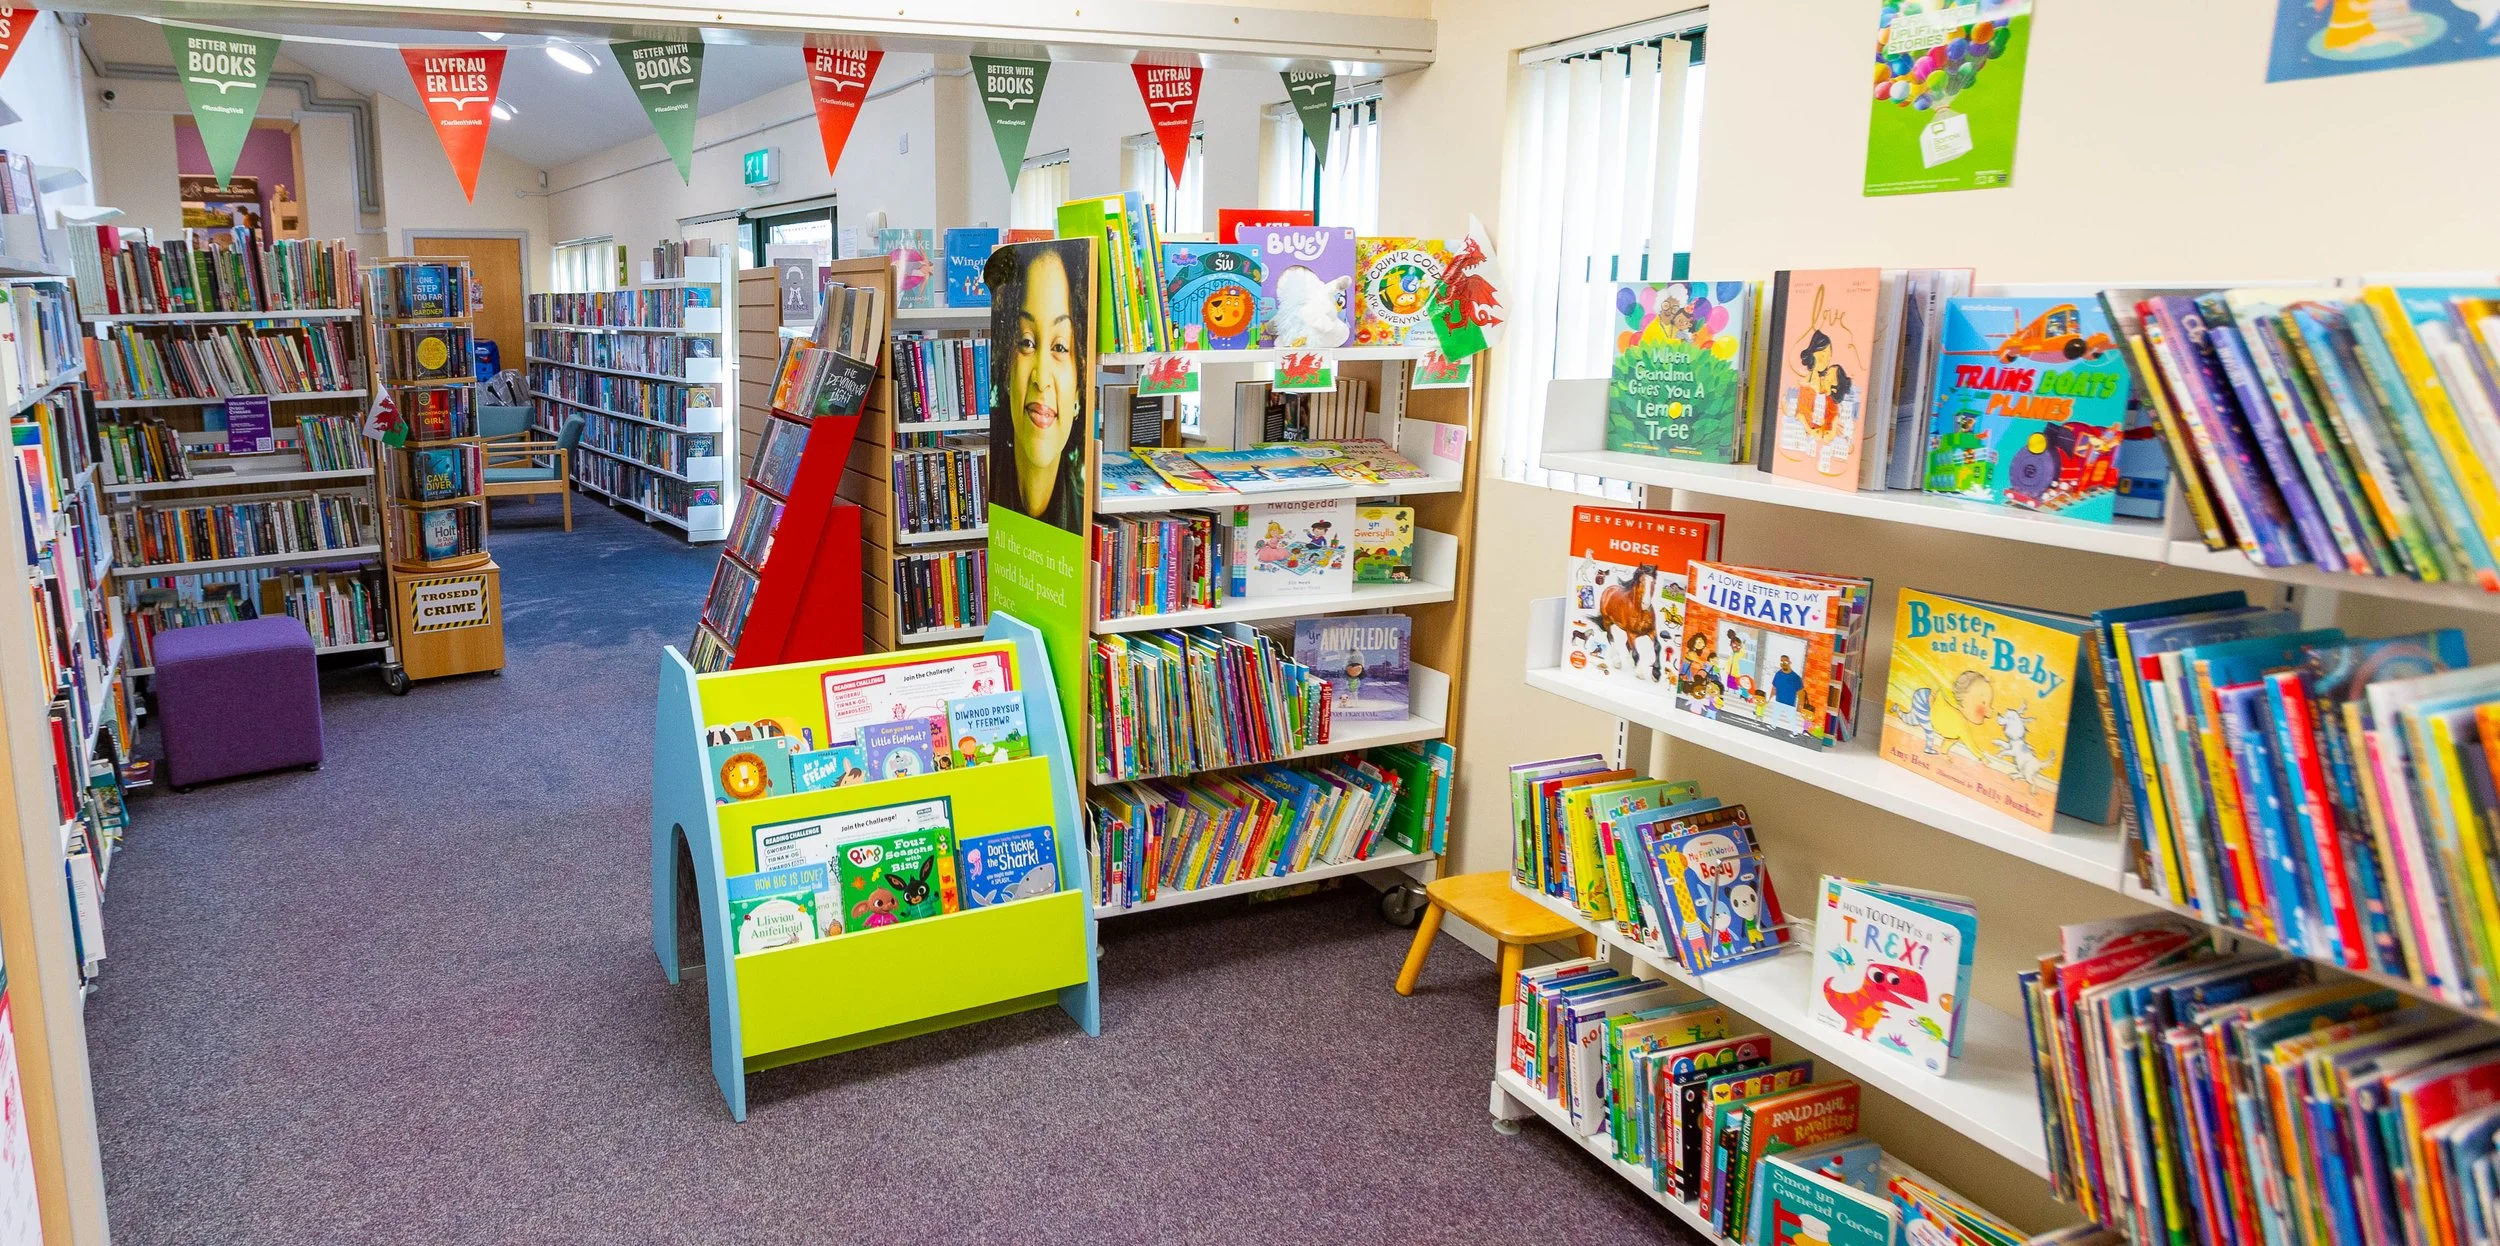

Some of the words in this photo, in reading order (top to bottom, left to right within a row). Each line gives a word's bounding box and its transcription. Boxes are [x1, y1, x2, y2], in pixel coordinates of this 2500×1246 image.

[188, 38, 227, 52] BETTER
[229, 42, 257, 56] WITH
[632, 47, 664, 59] BETTER
[665, 44, 688, 56] WITH
[1890, 34, 1943, 52] STORIES
[188, 52, 257, 77] BOOKS
[425, 57, 486, 72] LLYFRAU
[637, 56, 692, 79] BOOKS
[815, 57, 832, 72] ER
[835, 60, 866, 78] LLES
[987, 65, 1012, 75] BETTER
[1015, 66, 1034, 76] WITH
[427, 74, 447, 92] ER
[451, 74, 488, 92] LLES
[1147, 67, 1191, 82] LLYFRAU
[987, 76, 1034, 94] BOOKS
[1149, 84, 1164, 99] ER
[1166, 81, 1193, 97] LLES
[655, 103, 689, 112] #ReadingWell
[1267, 231, 1329, 261] BLUEY
[1215, 259, 1234, 271] SW
[1370, 252, 1408, 281] CRIW'R
[416, 285, 438, 293] STEP
[428, 293, 443, 301] FAR
[413, 308, 443, 316] GARDNER
[1378, 308, 1421, 325] GWENYN
[1652, 349, 1690, 364] When
[844, 367, 857, 379] THE
[1636, 362, 1694, 382] Grandma
[826, 373, 867, 396] DEVOURING
[1628, 379, 1659, 397] Gives
[1666, 385, 1691, 399] You
[1694, 385, 1705, 399] A
[1955, 365, 2036, 393] TRAINS
[2037, 371, 2120, 398] BOATS
[828, 390, 853, 404] LIGHT
[1636, 402, 1693, 419] Lemon
[1985, 393, 2074, 422] PLANES
[424, 417, 444, 425] GIRL
[1284, 431, 1297, 440] ROY
[1645, 421, 1689, 440] Tree
[426, 473, 449, 483] CAVE
[426, 481, 452, 491] DIVER
[427, 520, 446, 528] Anne
[435, 526, 456, 538] Holt
[1594, 515, 1698, 537] EYEWITNESS
[1354, 529, 1395, 539] Gwersylla
[994, 529, 1006, 549] All
[1008, 535, 1021, 555] the
[1023, 546, 1043, 564] cares
[1046, 550, 1055, 571] in
[1058, 556, 1074, 578] the
[1609, 538, 1660, 557] HORSE
[994, 562, 1017, 583] world
[1019, 568, 1034, 591] had
[1036, 583, 1067, 608] passed.
[1708, 571, 1715, 581] A
[1718, 575, 1744, 590] LOVE
[1747, 583, 1781, 599] LETTER
[1784, 590, 1799, 602] TO
[1803, 592, 1819, 604] MY
[421, 588, 479, 603] TROSEDD
[994, 586, 1017, 613] Peace.
[423, 602, 476, 617] CRIME
[1708, 584, 1811, 627] LIBRARY
[1908, 601, 1995, 639] Buster
[1308, 630, 1320, 644] Yr
[1320, 627, 1399, 650] ANWELEDIG
[916, 672, 925, 680] the
[926, 666, 955, 678] Challenge!
[1932, 637, 1957, 652] and
[1962, 637, 1988, 660] the
[1990, 637, 2065, 698] Baby
[955, 708, 990, 720] DIWRNOD
[992, 704, 1020, 715] PRYSUR
[968, 721, 973, 729] Y
[976, 716, 1010, 728] FFERMWR
[871, 737, 891, 748] Little
[892, 731, 926, 745] Elephant?
[802, 758, 837, 784] FFERM!
[804, 763, 813, 771] Ar
[1890, 746, 1908, 762] Amy
[1911, 754, 1930, 770] Hest
[1976, 783, 2001, 802] Polly
[2005, 796, 2043, 819] Dunbar
[865, 814, 897, 826] Challenge!
[765, 835, 790, 844] READING
[789, 828, 820, 839] CHALLENGE
[894, 837, 926, 849] Four
[766, 844, 794, 854] GWOBRAU
[850, 848, 881, 864] Bing
[885, 844, 934, 860] Seasons
[987, 843, 1008, 857] Don't
[1010, 839, 1034, 853] tickle
[1688, 853, 1698, 862] My
[1700, 848, 1715, 859] First
[1715, 844, 1735, 855] Words
[891, 861, 920, 872] Bing
[987, 858, 999, 868] the
[999, 848, 1040, 870] Shark!
[755, 878, 771, 891] HOW
[774, 874, 787, 888] BIG
[790, 872, 798, 885] IS
[801, 869, 824, 883] LOVE?
[757, 914, 795, 927] Lliwiau
[1843, 902, 1865, 918] HOW
[1866, 907, 1913, 934] TOOTHY
[1842, 915, 1858, 944] T.
[1864, 924, 1930, 970] REX?
[1772, 1107, 1811, 1127] ROALD
[1814, 1097, 1846, 1117] DAHL
[1794, 1113, 1853, 1140] Revolting
[1774, 1170, 1813, 1195] Smot
[1816, 1191, 1835, 1206] yn
[1773, 1182, 1833, 1216] Gwneud
[1836, 1211, 1884, 1241] Cacen
